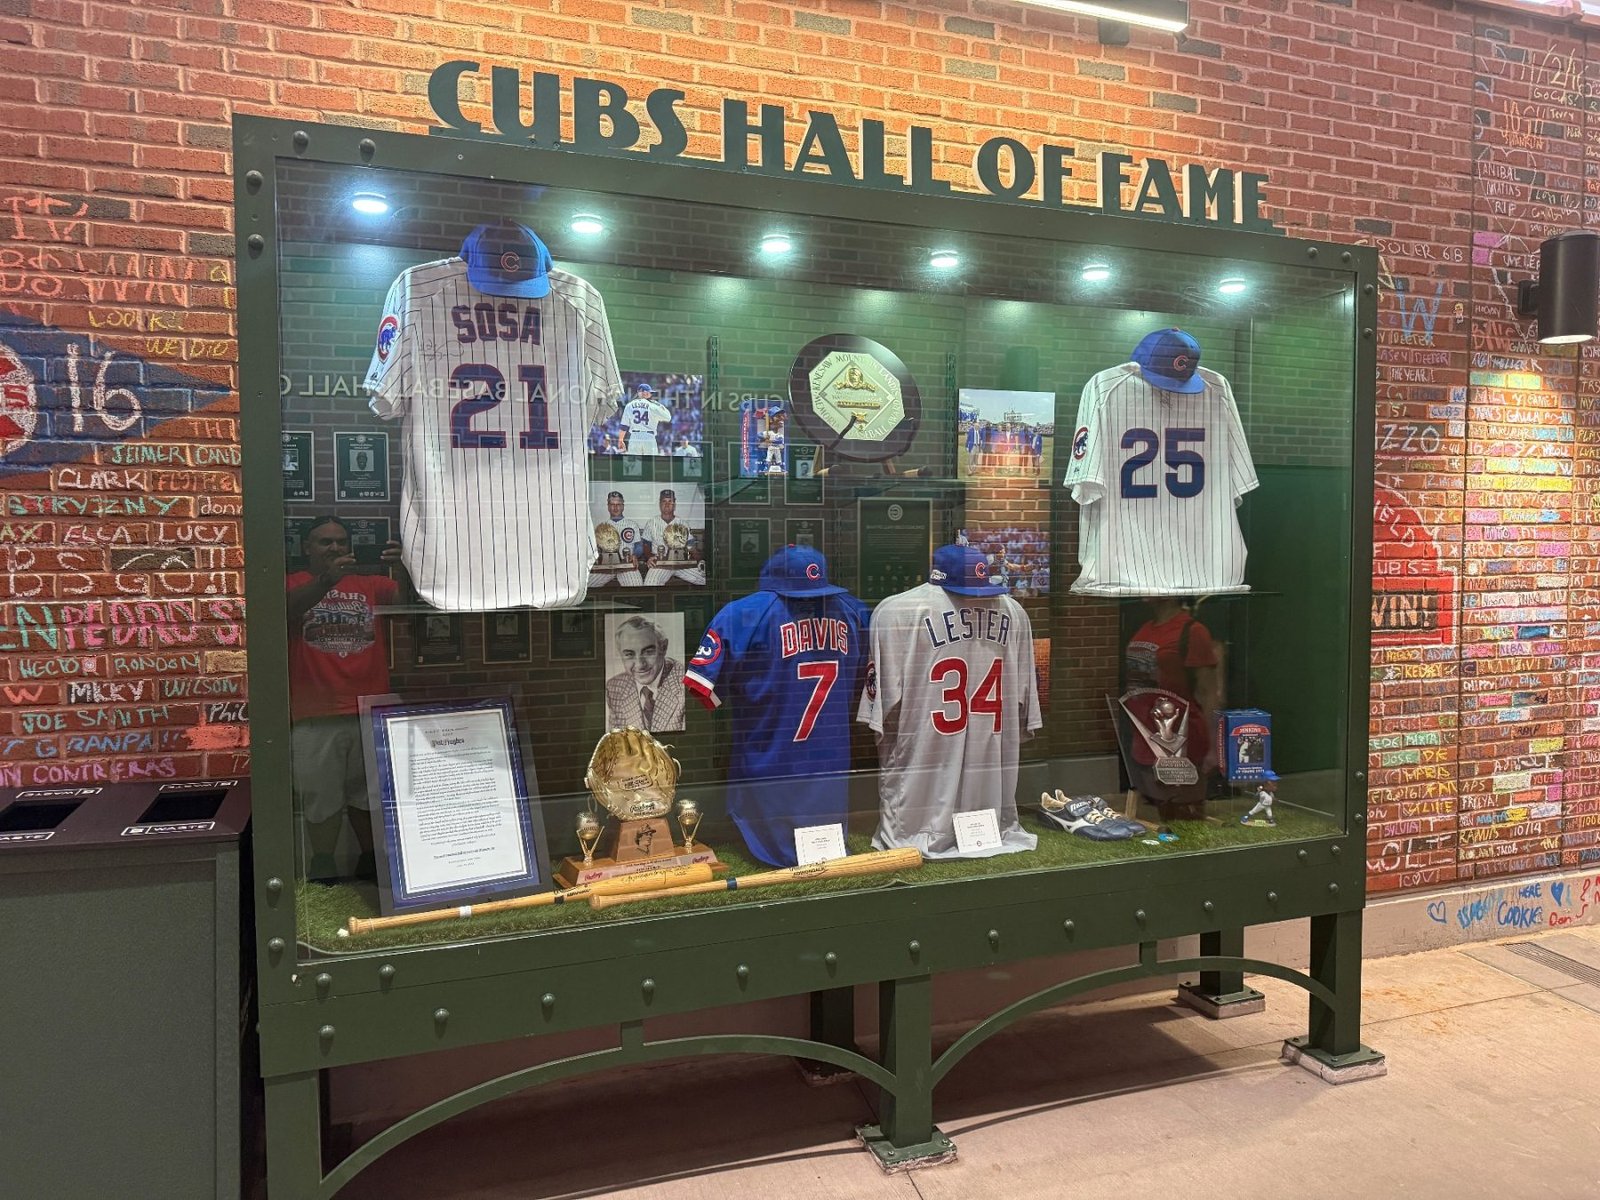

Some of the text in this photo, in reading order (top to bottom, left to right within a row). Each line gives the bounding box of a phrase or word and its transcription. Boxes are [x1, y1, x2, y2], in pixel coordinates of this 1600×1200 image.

[428, 60, 1273, 229] CUBS HALL OF FAME
[451, 302, 542, 345] SOSA
[66, 341, 143, 432] 16
[450, 362, 560, 450] 21
[632, 409, 650, 426] 34
[57, 467, 146, 489] CLARK
[1120, 427, 1206, 499] 25
[63, 522, 132, 544] ELLA
[157, 521, 230, 543] LUCY
[1373, 560, 1419, 575] UBS
[780, 617, 849, 659] DAVIS
[924, 608, 1011, 651] LESTER
[793, 660, 840, 742] 7
[929, 657, 1004, 736] 34
[21, 712, 68, 735] JOE
[32, 756, 177, 784] CONTRERAS
[153, 823, 209, 832] WASTE
